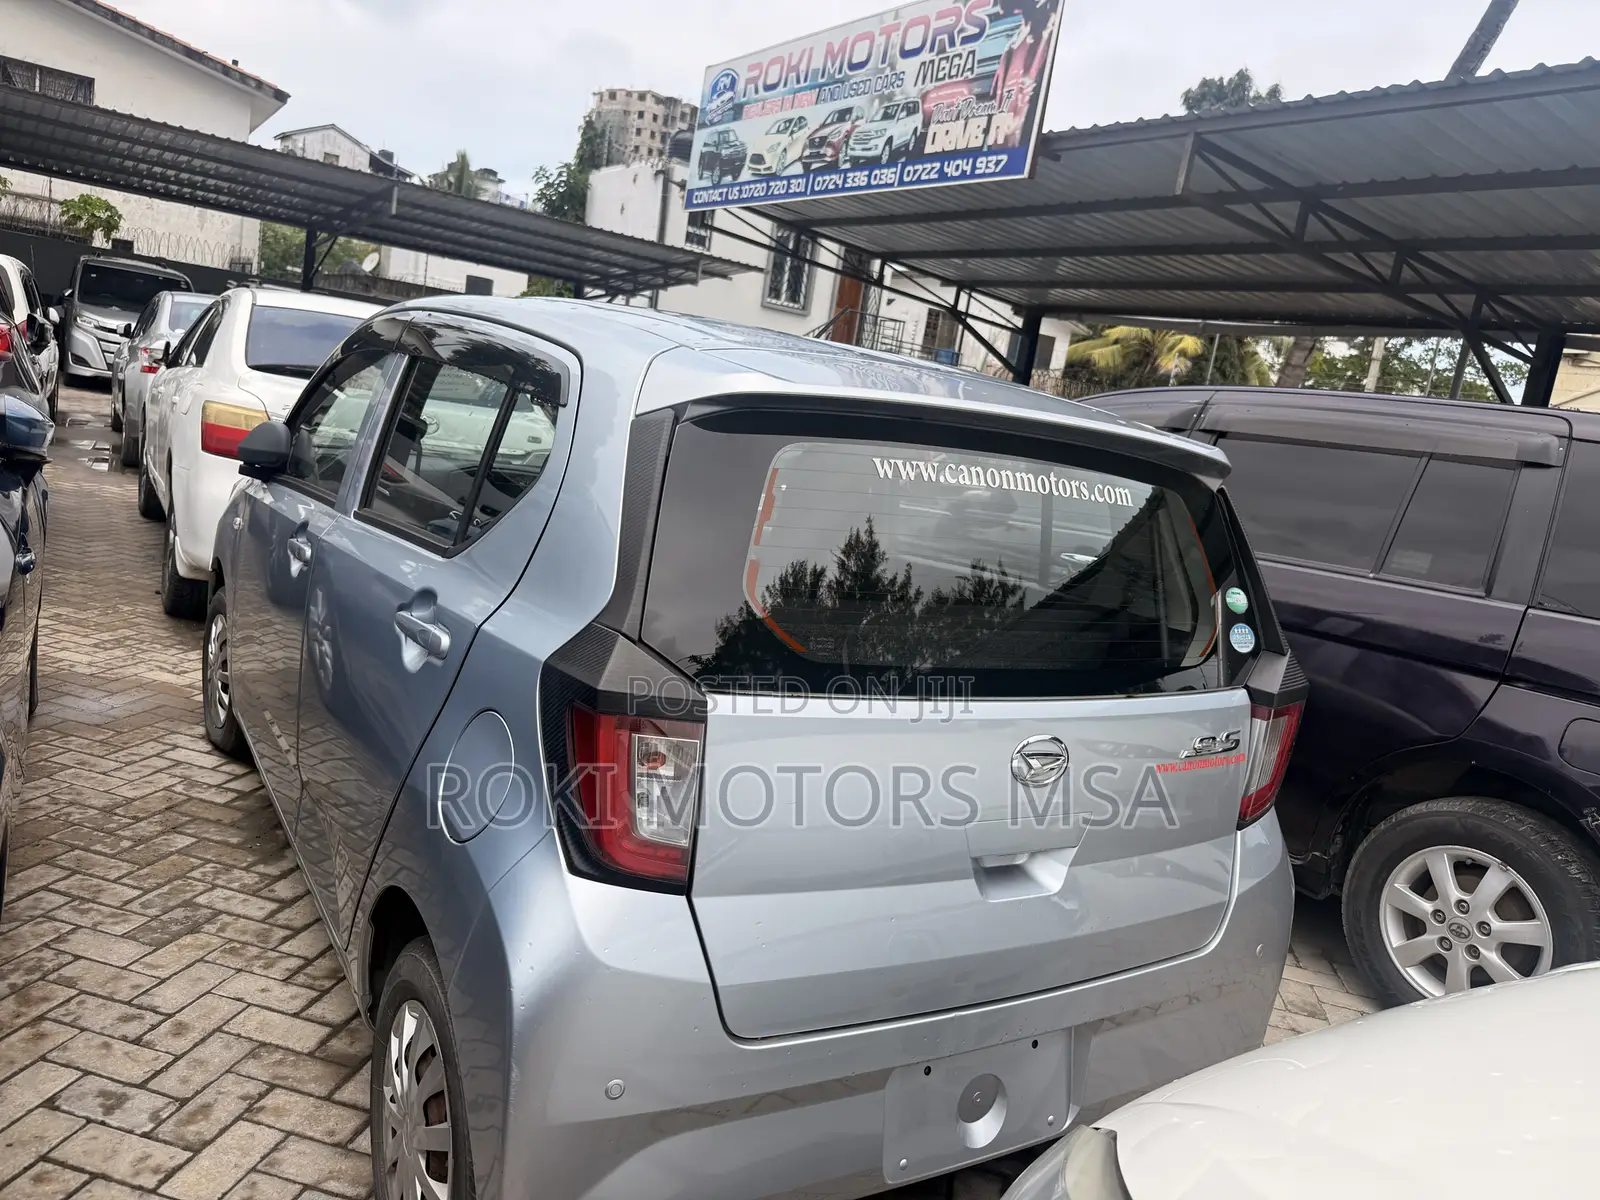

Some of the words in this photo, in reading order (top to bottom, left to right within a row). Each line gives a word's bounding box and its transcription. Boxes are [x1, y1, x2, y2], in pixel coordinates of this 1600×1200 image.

[742, 46, 814, 99] ROKI
[820, 0, 990, 80] MOTORS
[914, 49, 976, 88] MEGA
[820, 84, 842, 104] AND
[842, 77, 872, 100] USED
[874, 71, 906, 94] CARS
[693, 188, 727, 204] CONTACT
[728, 186, 739, 200] US
[768, 180, 787, 195] 720
[788, 178, 806, 193] 301
[814, 173, 844, 191] 0724
[844, 170, 867, 188] 336
[903, 162, 941, 182] 0722
[944, 158, 973, 177] 404
[975, 154, 1009, 174] 937
[872, 457, 1134, 507] www.canonmotors.com
